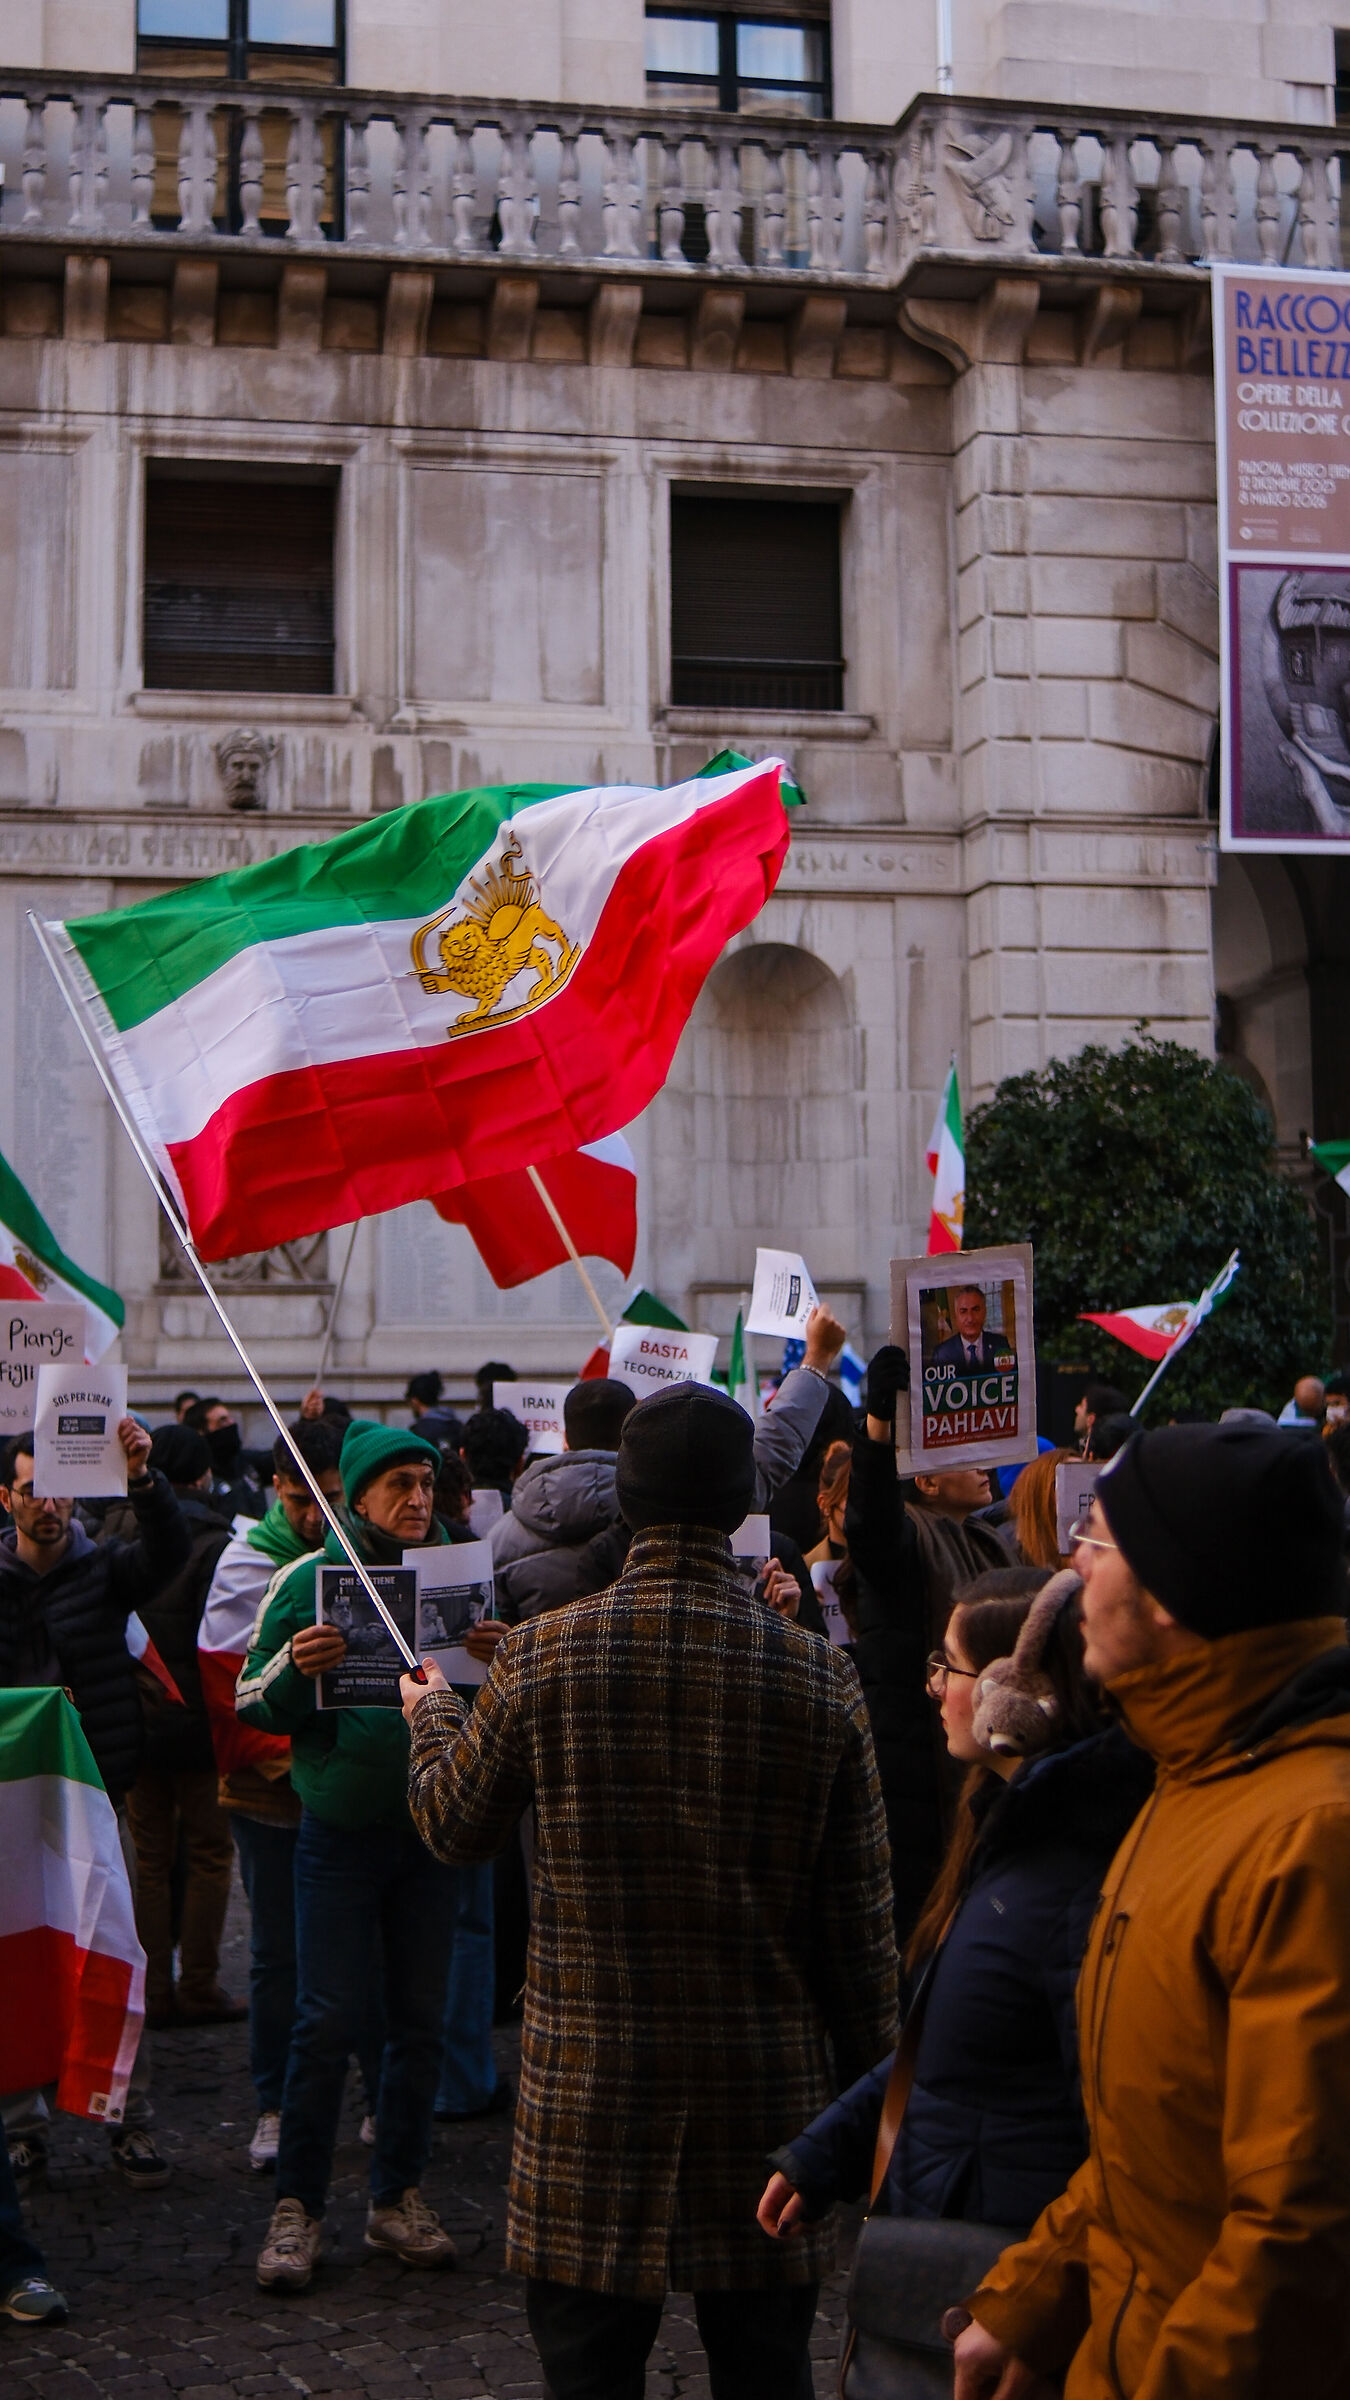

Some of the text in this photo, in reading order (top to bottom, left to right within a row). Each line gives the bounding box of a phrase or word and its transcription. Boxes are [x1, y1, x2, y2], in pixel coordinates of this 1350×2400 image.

[1237, 382, 1343, 409] OPERE DELLA
[1237, 409, 1338, 436] COLLEZIONE
[9, 1318, 75, 1357] Piange
[640, 1340, 688, 1360] BASTA
[624, 1361, 697, 1381] TEOCRAZIA!
[925, 1364, 956, 1382] OUR
[52, 1392, 113, 1408] SOS PER L'IRAN
[522, 1397, 555, 1409] IRAN
[925, 1376, 1015, 1412] VOICE
[524, 1419, 559, 1432] EEDS
[926, 1407, 1016, 1438] PAHLAVI
[339, 1576, 396, 1586] CHI STIENE
